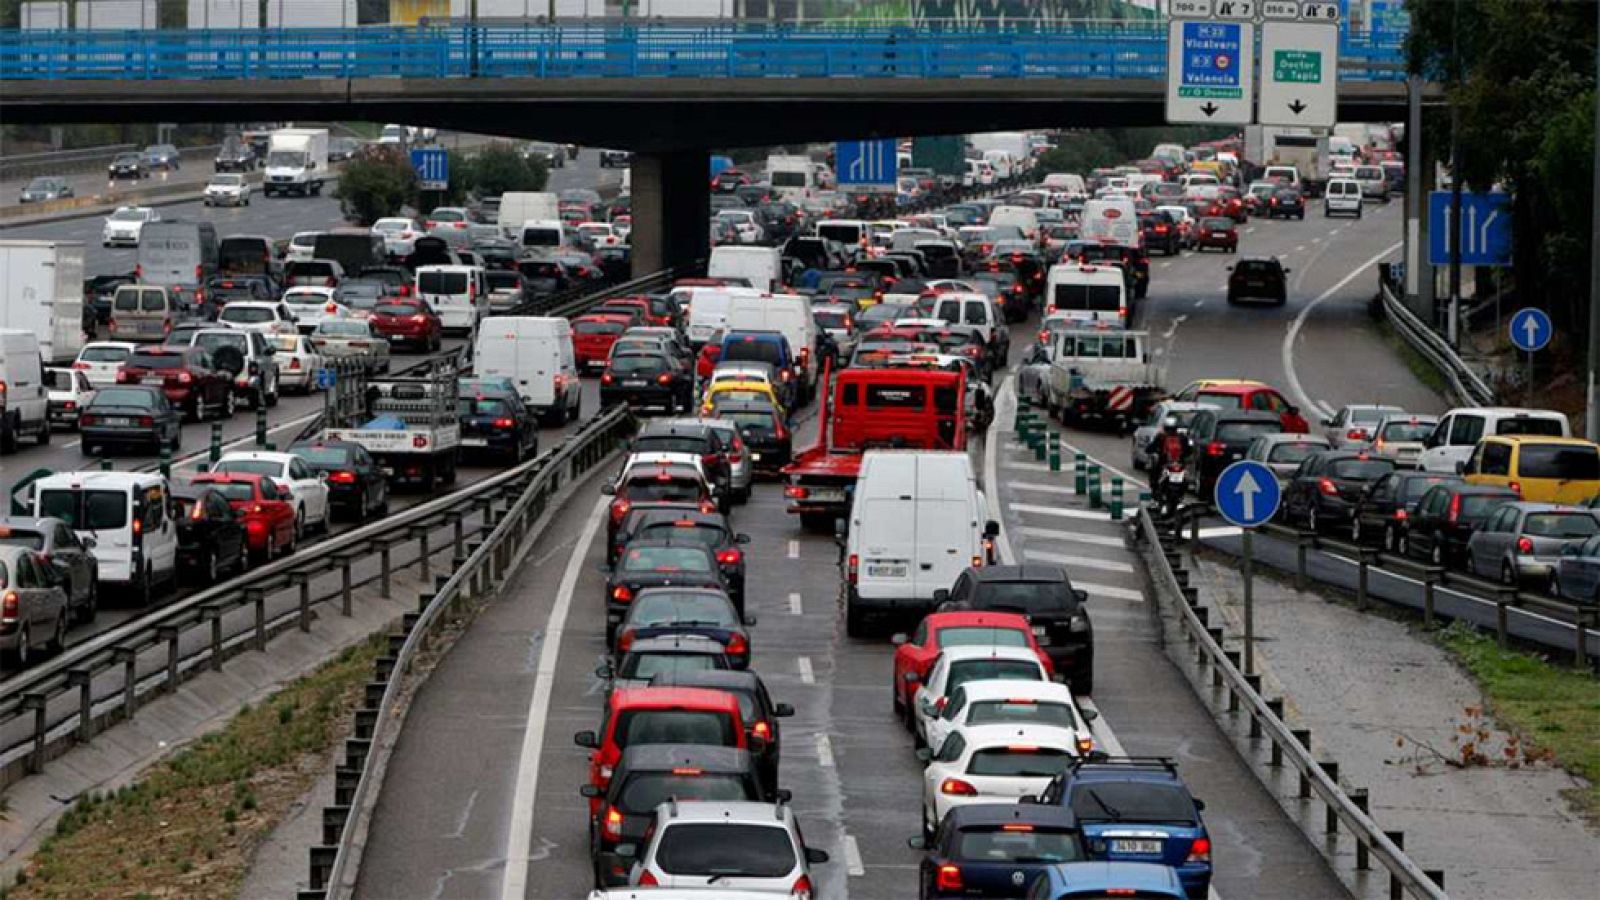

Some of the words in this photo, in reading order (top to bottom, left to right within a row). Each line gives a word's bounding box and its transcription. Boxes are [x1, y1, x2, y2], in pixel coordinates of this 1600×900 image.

[1243, 4, 1250, 14] 7
[1327, 7, 1335, 18] 8
[1280, 59, 1316, 70] Doctor
[1187, 72, 1235, 84] Valencia
[1291, 70, 1319, 81] Tapia
